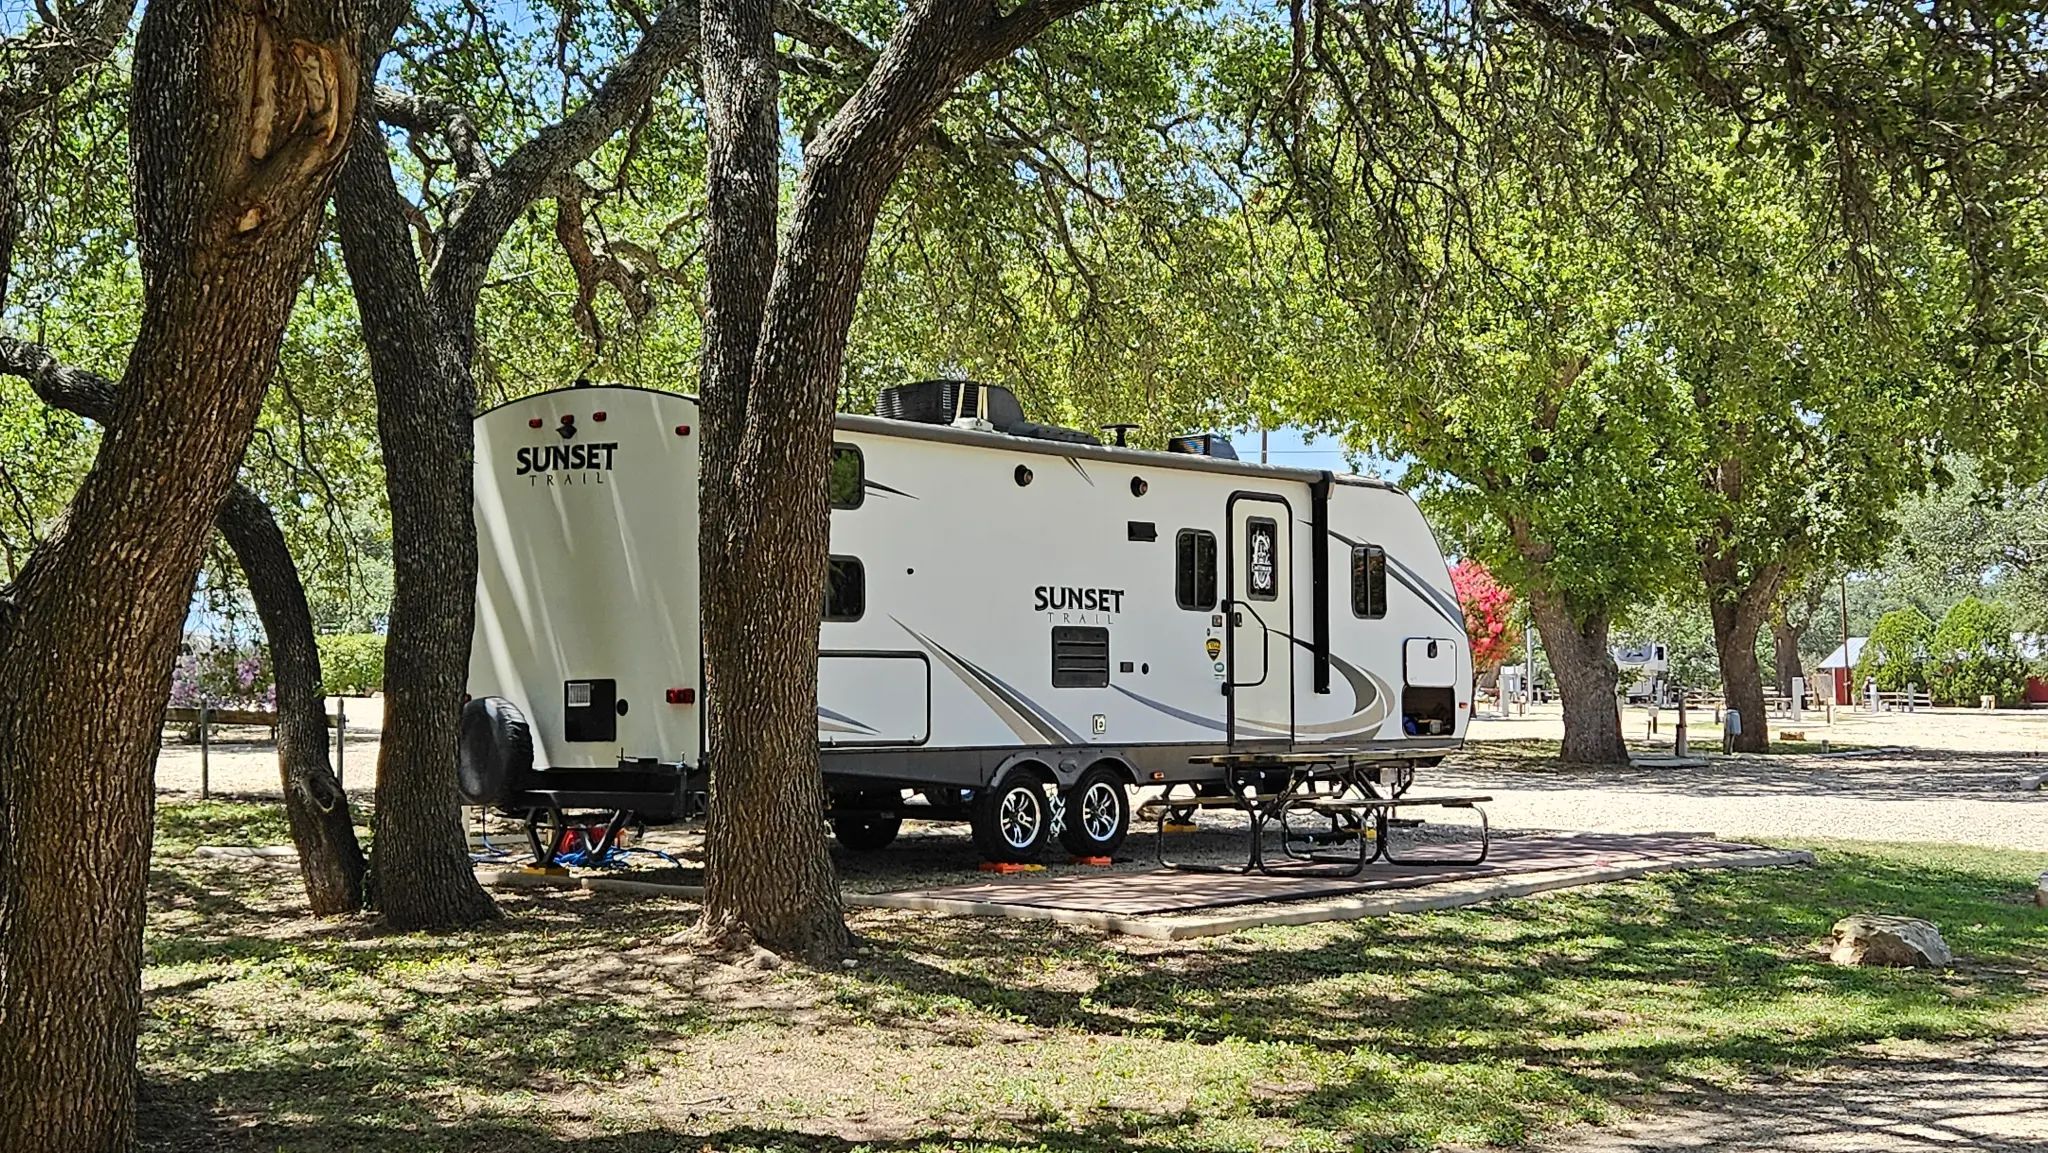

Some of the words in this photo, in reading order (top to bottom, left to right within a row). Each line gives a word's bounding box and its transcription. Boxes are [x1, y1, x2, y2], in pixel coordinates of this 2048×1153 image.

[516, 442, 618, 475] SUNSET
[529, 472, 604, 487] TRAIL
[1034, 586, 1125, 614] SUNSET
[1047, 612, 1114, 625] TRAIL
